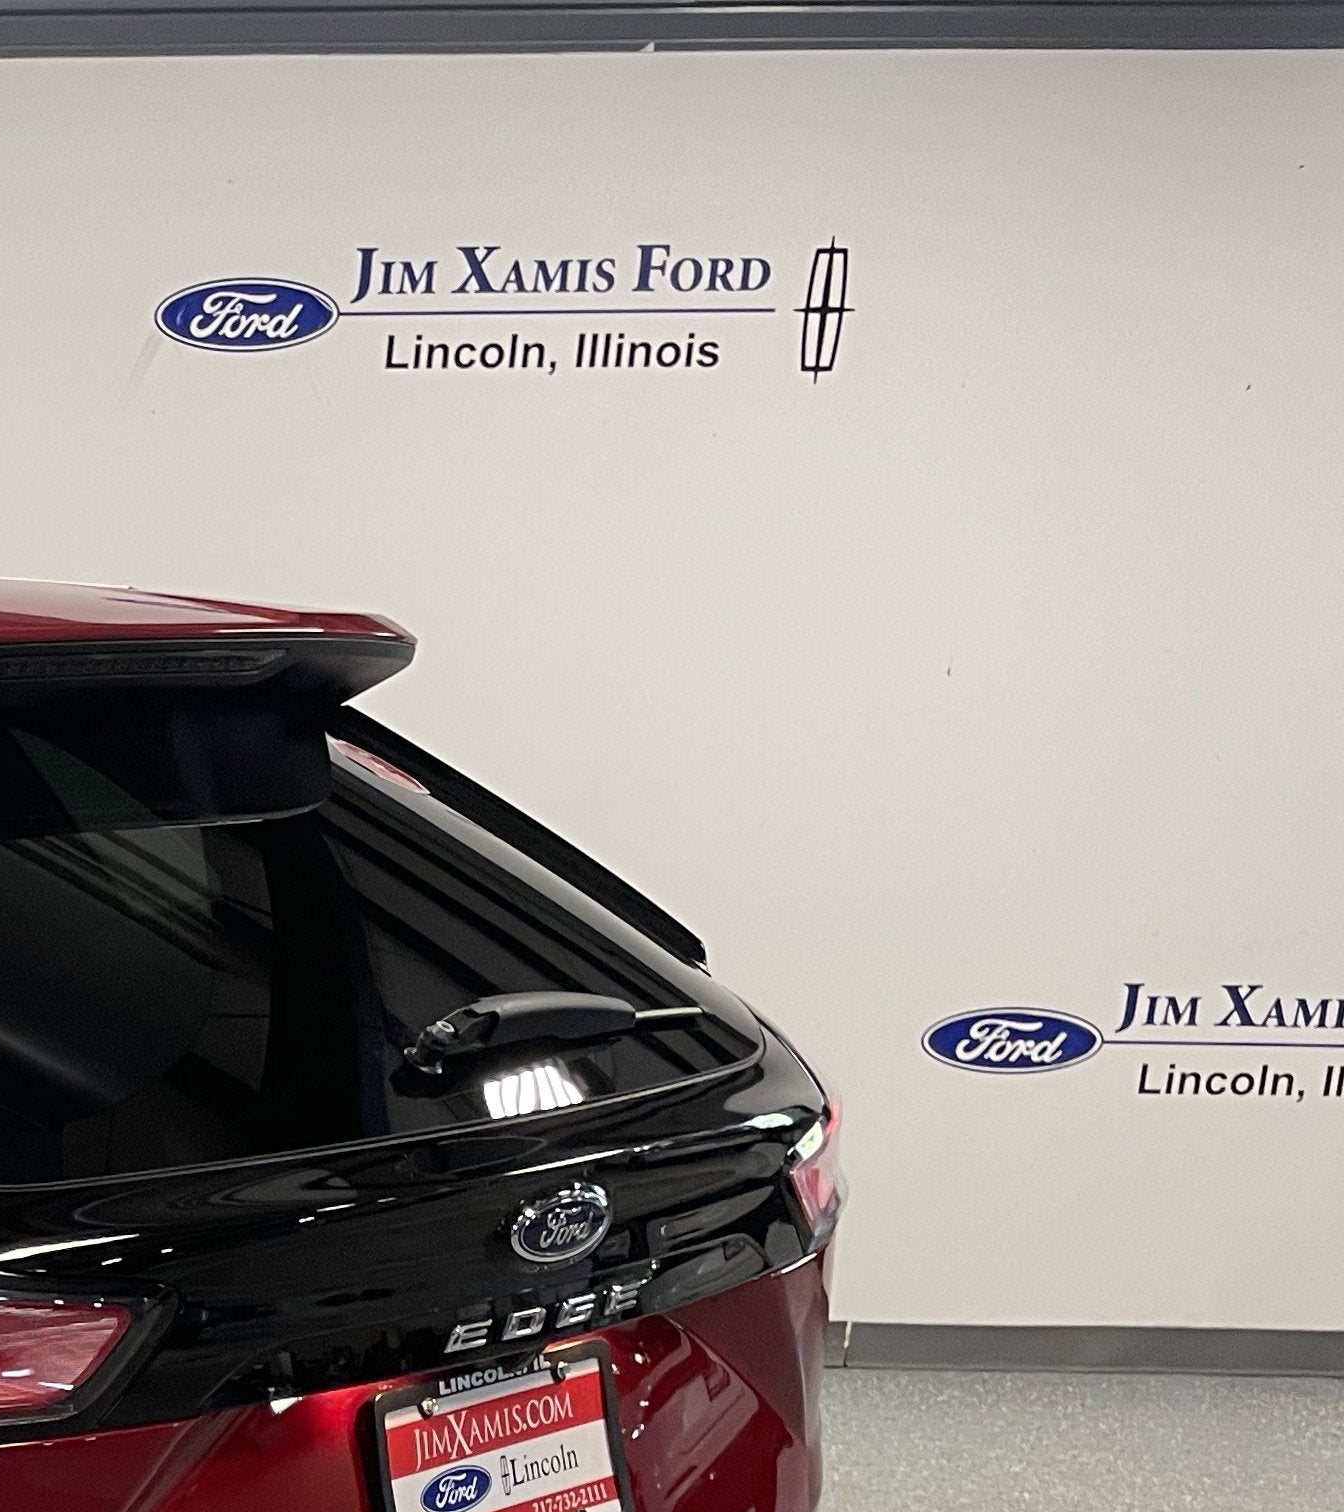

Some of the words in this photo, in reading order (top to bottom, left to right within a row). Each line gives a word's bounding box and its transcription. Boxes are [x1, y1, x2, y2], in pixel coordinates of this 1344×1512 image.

[188, 291, 300, 340] Ford
[385, 334, 558, 374] Lincoln,
[576, 332, 721, 369] Illinois
[955, 1018, 1067, 1064] Ford
[1138, 1063, 1305, 1103] Lincoln,
[443, 1280, 644, 1353] EDGE
[438, 1365, 528, 1396] LINCOL,
[436, 1473, 479, 1508] Ford
[510, 1444, 579, 1486] Lincoln
